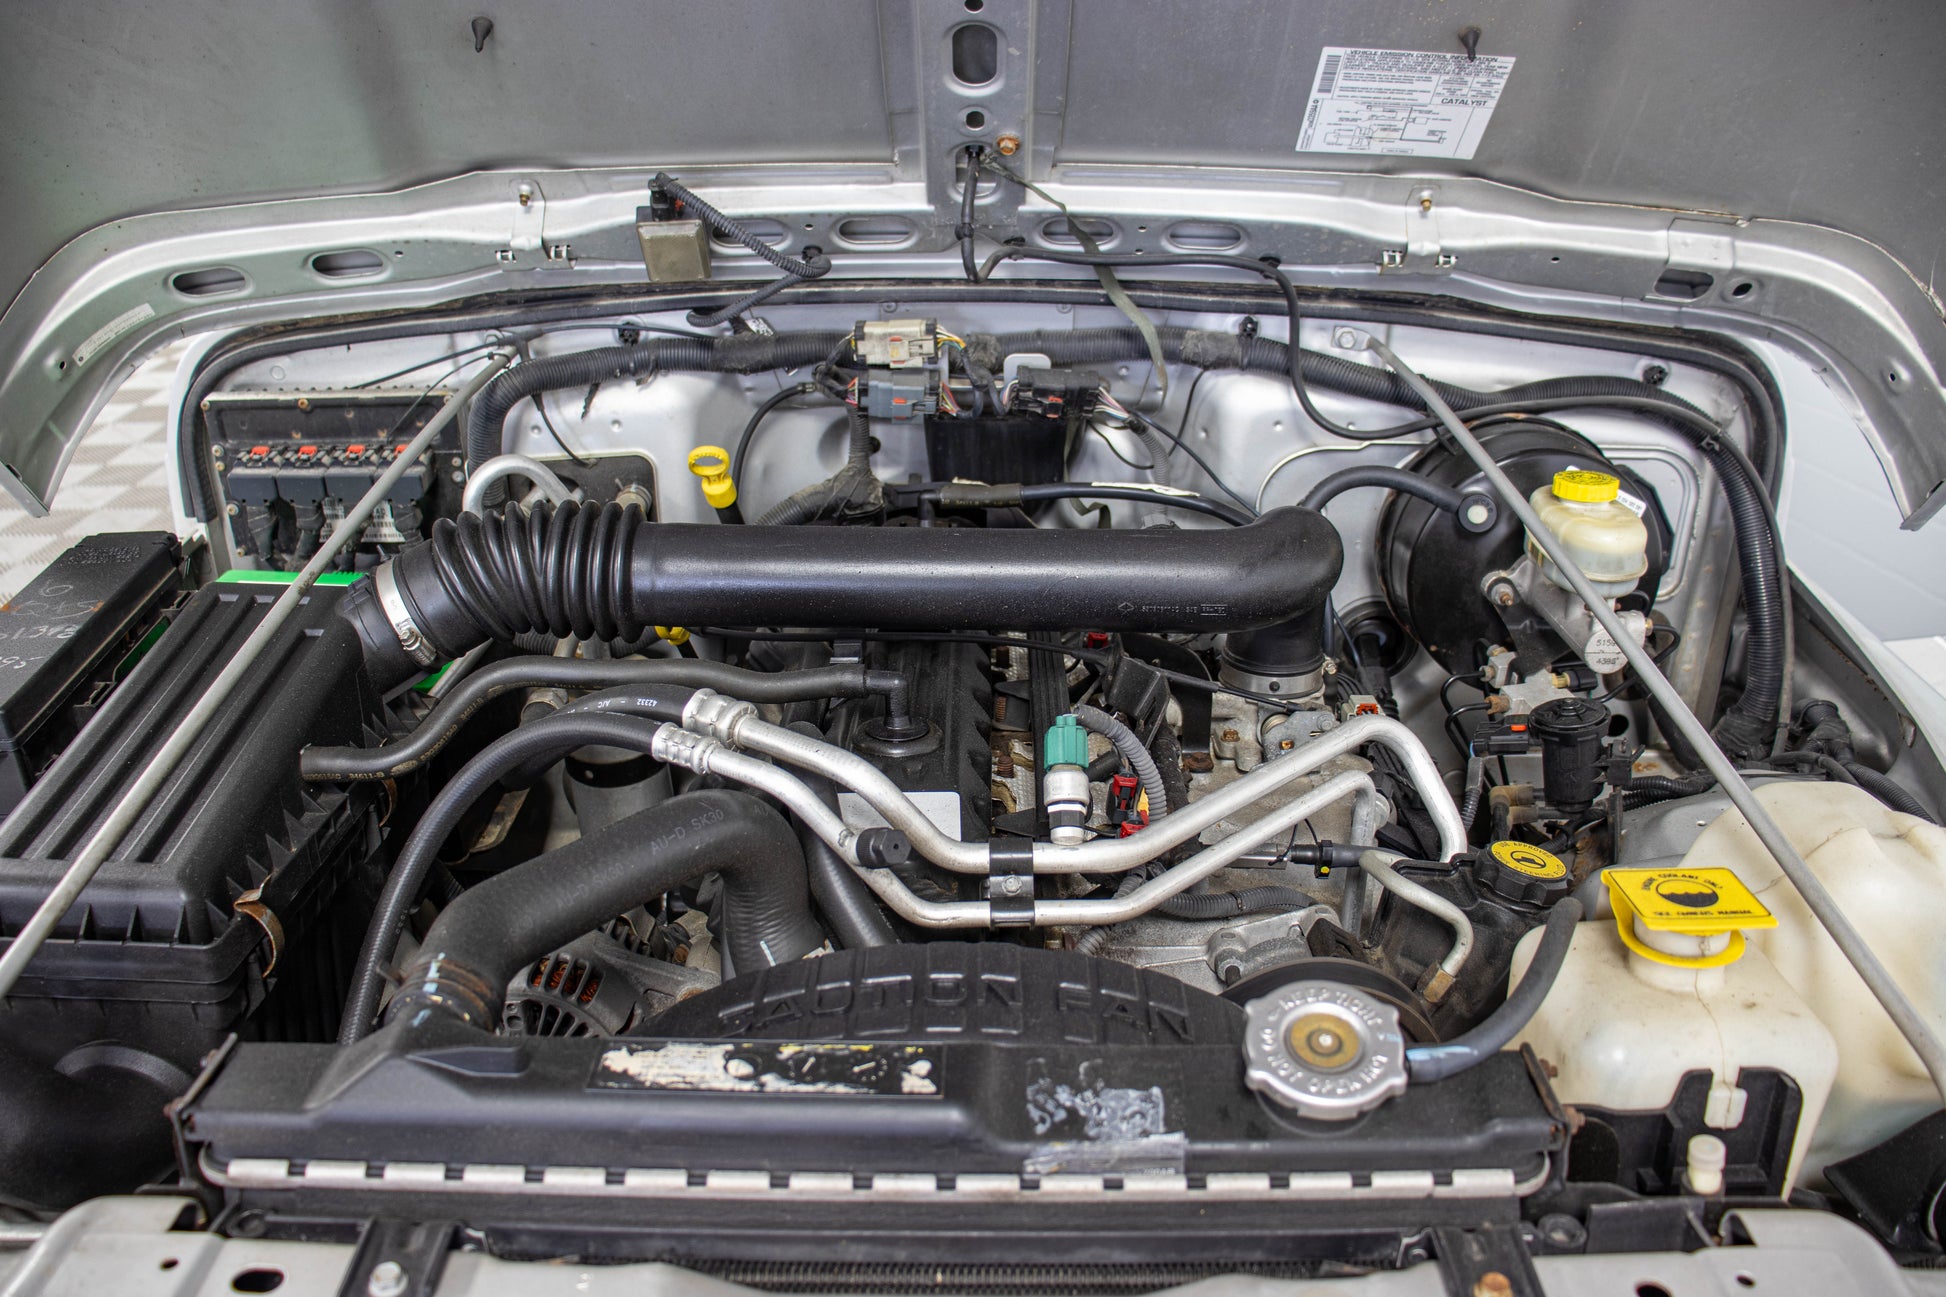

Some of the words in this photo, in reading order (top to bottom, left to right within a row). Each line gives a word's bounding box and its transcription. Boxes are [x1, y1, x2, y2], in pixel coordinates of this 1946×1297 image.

[1441, 97, 1488, 107] CATALYST
[597, 699, 611, 709] A/C
[636, 698, 658, 707] 42332
[651, 825, 686, 856] AU-D
[690, 807, 725, 831] SK30
[1279, 988, 1330, 1011] KEEP
[1055, 980, 1195, 1043] FAN
